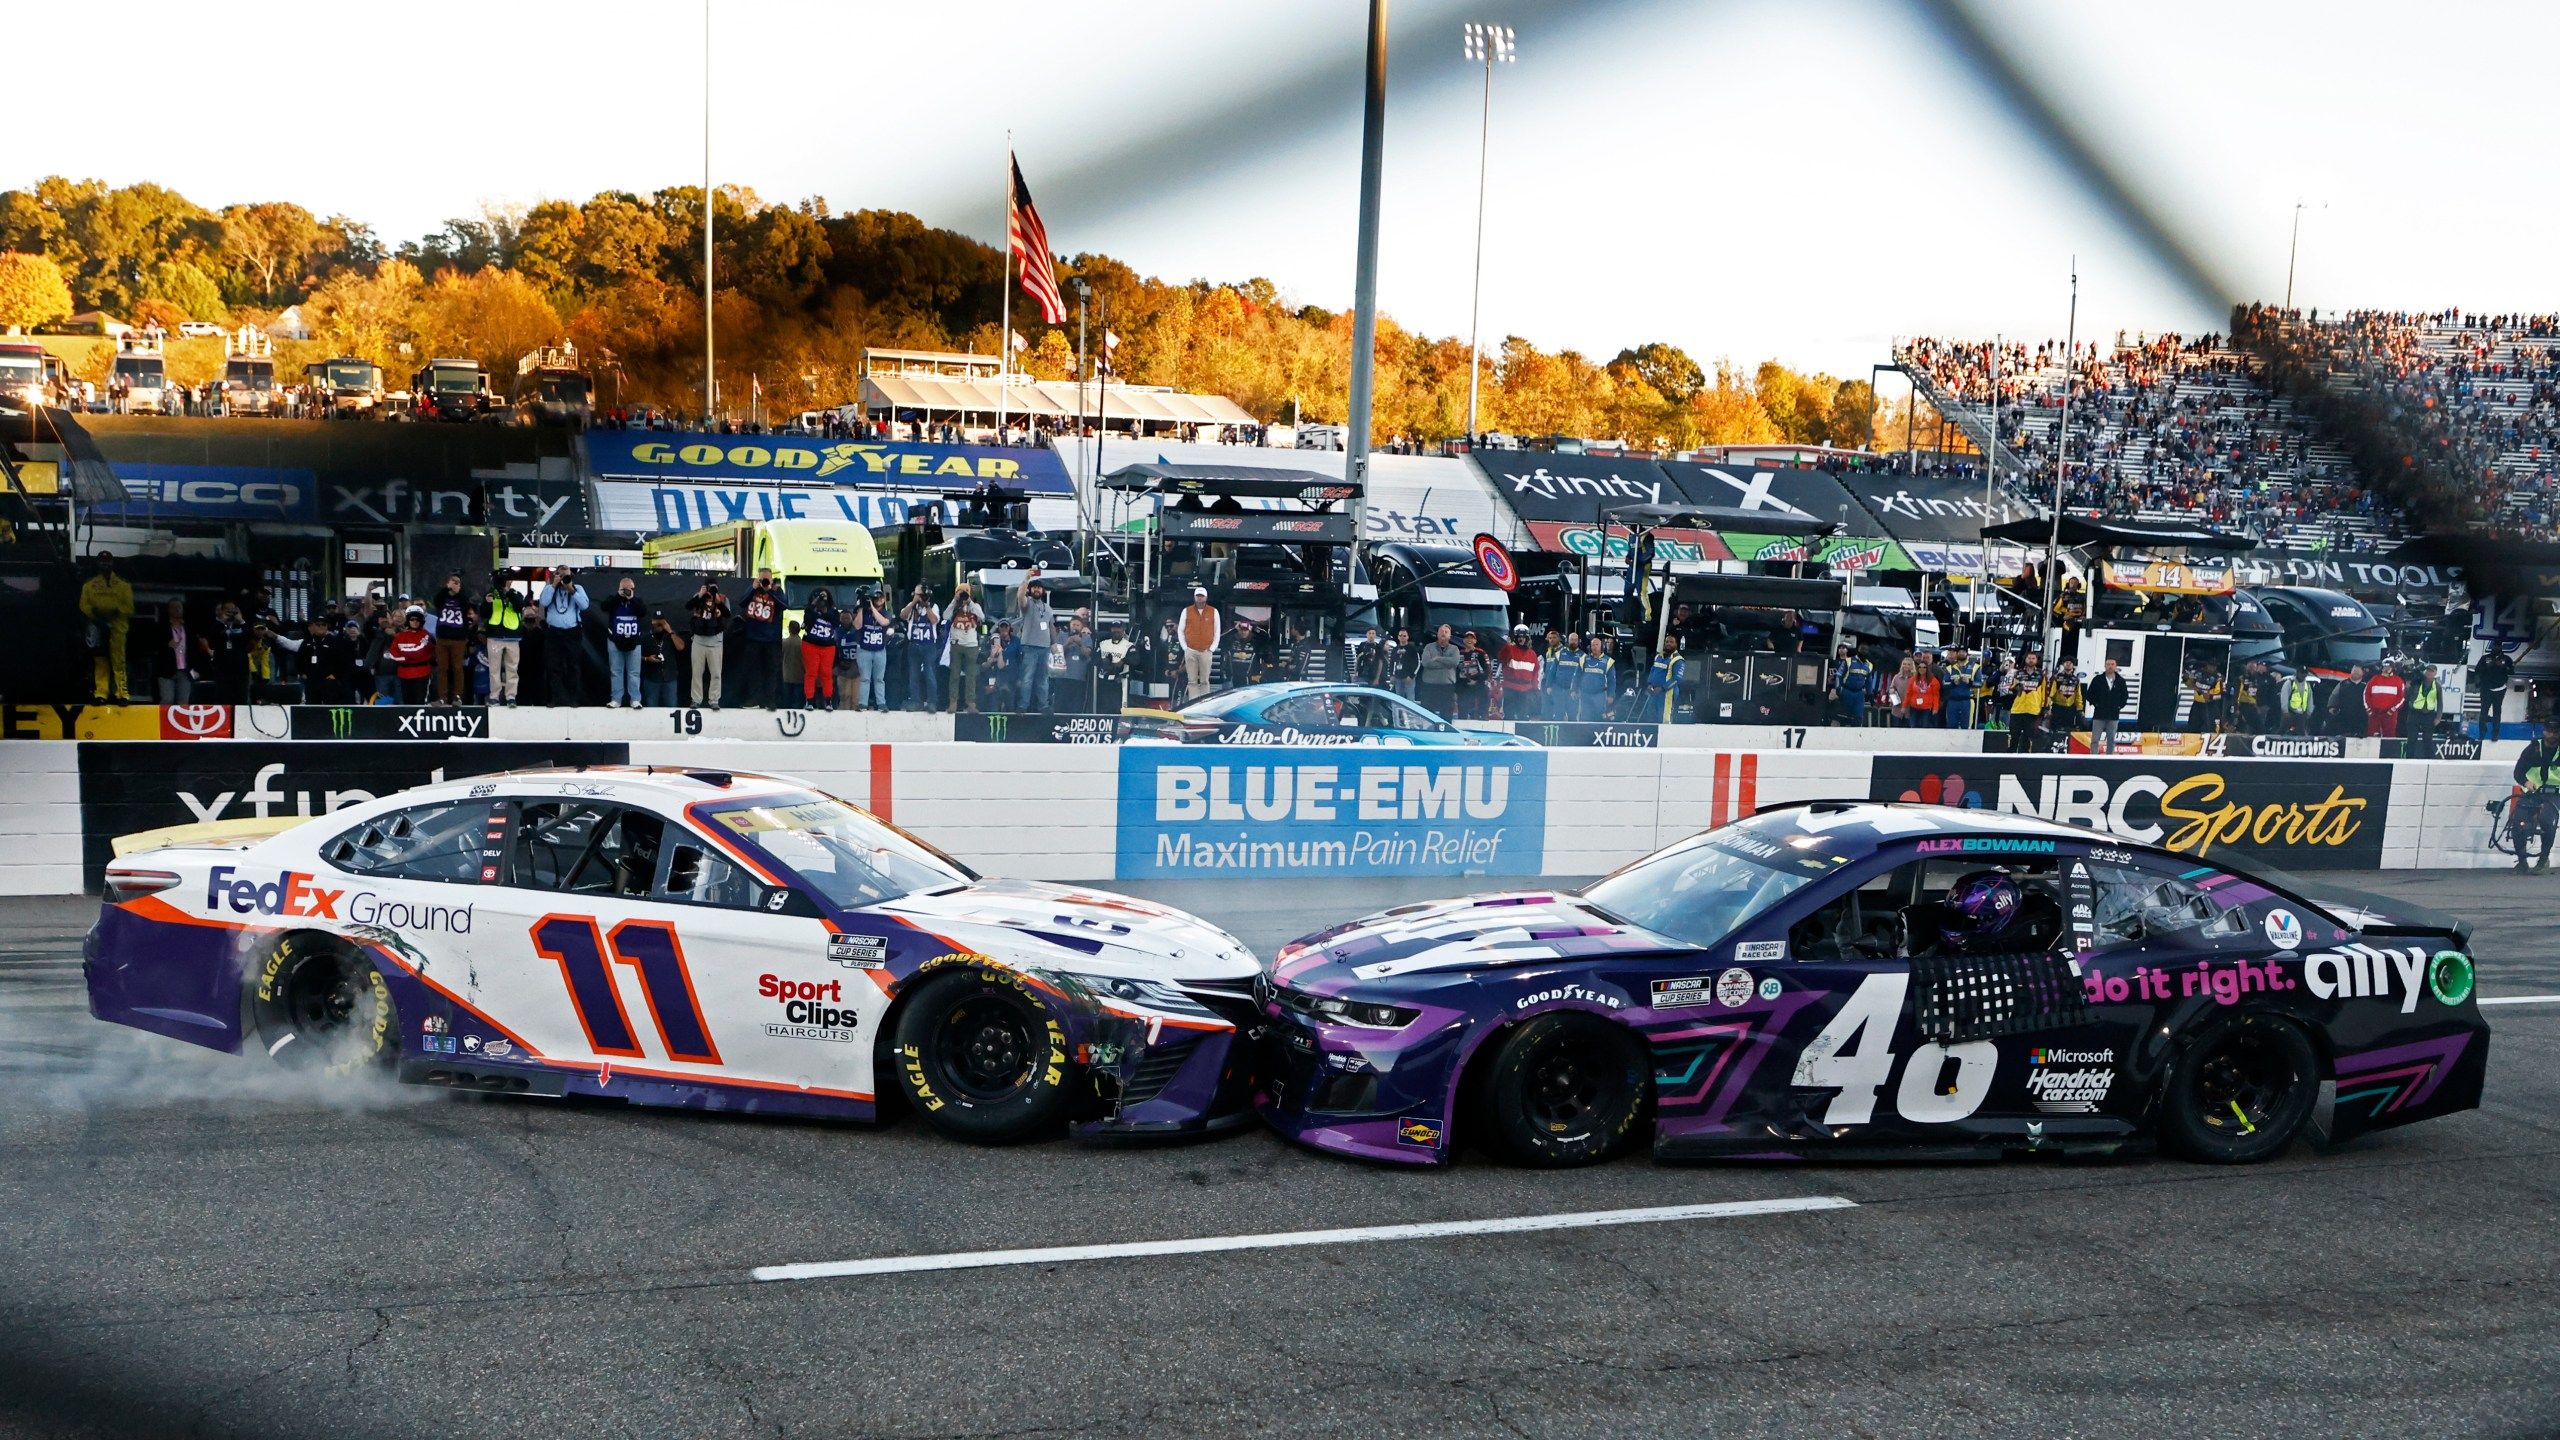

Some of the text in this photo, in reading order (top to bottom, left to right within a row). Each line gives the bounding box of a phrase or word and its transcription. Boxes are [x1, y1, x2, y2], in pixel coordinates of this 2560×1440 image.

[119, 478, 300, 507] EICO
[1503, 468, 1661, 504] xfinity
[333, 479, 571, 527] xfinty
[651, 488, 811, 533] DIXIE
[2156, 565, 2182, 588] 14
[398, 708, 482, 738] xfinity
[670, 710, 702, 735] 19
[1070, 718, 1113, 732] DEAD ON
[1069, 733, 1113, 744] TOOLS
[1218, 723, 1354, 745] Auto-Owners
[1592, 726, 1654, 748] xfinity
[1783, 727, 1807, 749] 17
[2196, 732, 2228, 757] 14
[2251, 735, 2340, 757] Cummins
[2435, 739, 2479, 759] xfinity
[1155, 765, 1510, 822] BLUE-EMU
[1997, 772, 2368, 858] NBC Sports
[1155, 827, 1507, 868] Maximum Pain Relief
[207, 865, 474, 935] FedEx Ground
[1994, 889, 2014, 911] ally
[847, 936, 879, 946] NASCAR
[1751, 942, 1779, 951] NASCAR
[2269, 930, 2300, 941] VALVOLINE
[835, 946, 878, 958] CUP SERIES
[258, 939, 293, 1002] EAGLE
[850, 960, 877, 969] PLAYOFFS
[529, 911, 723, 1066] 11
[758, 973, 842, 1004] Sport
[1670, 980, 1702, 990] NASCAR
[1724, 982, 1748, 990] WINS
[2085, 959, 2296, 1006] do it right.
[2304, 942, 2427, 1014] ally
[1660, 992, 1702, 1003] CUP SERIES
[1719, 988, 1751, 997] RECORD
[786, 1000, 858, 1029] Clips
[769, 1025, 851, 1041] HAIRCUTS
[2047, 1049, 2114, 1063] Microsoft
[904, 1042, 945, 1112] EAGLE
[2026, 1068, 2116, 1096] Hendrick
[2041, 1087, 2109, 1102] cars.com
[1401, 1127, 1440, 1139] SUNOCO
